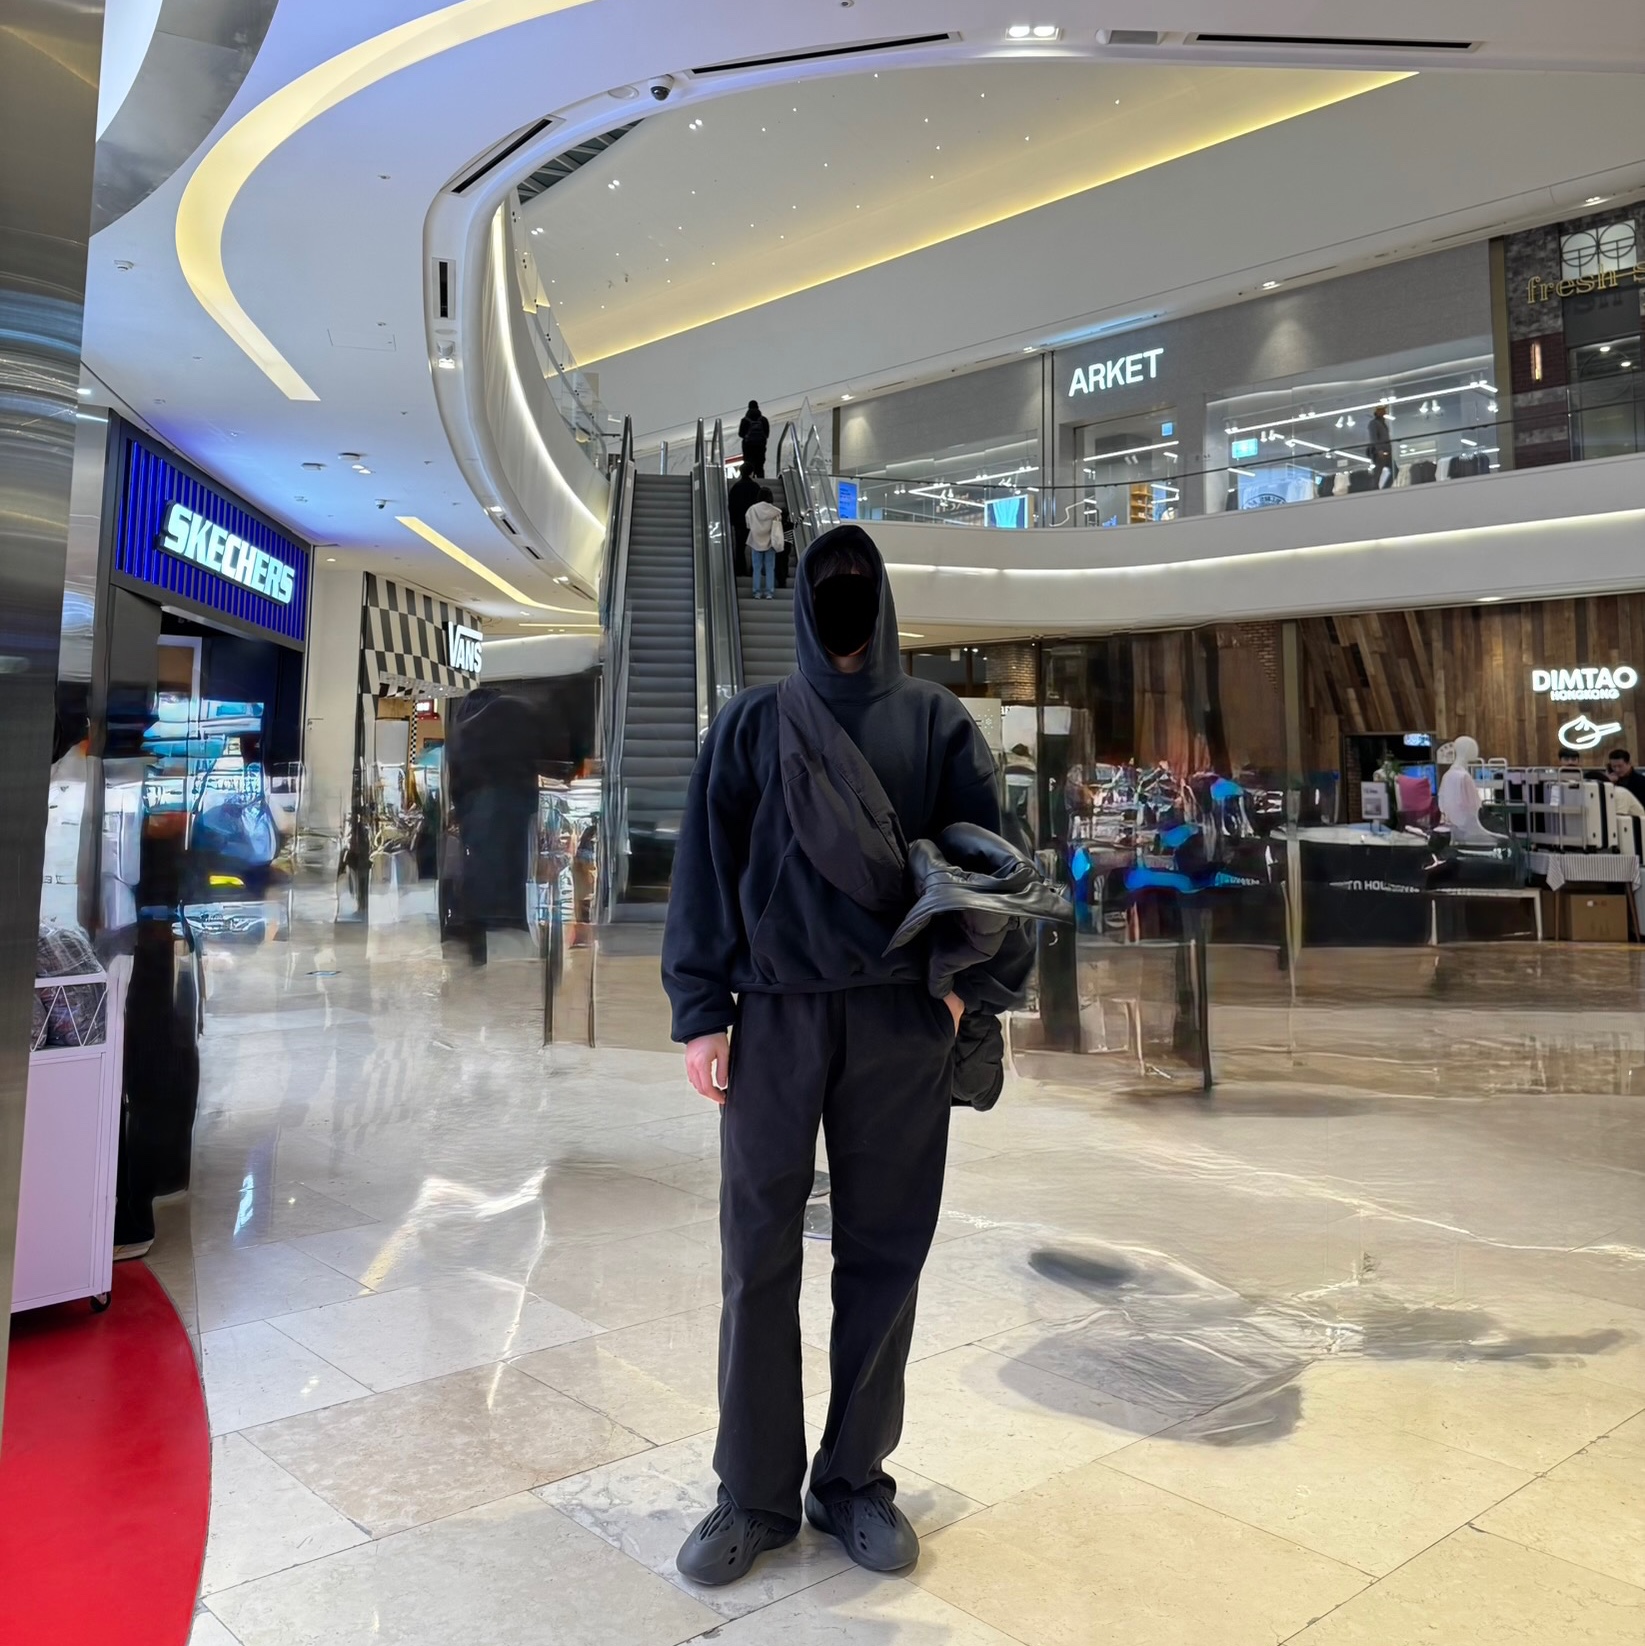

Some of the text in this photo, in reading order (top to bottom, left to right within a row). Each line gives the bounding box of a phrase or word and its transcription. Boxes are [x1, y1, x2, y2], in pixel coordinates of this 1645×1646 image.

[1526, 263, 1618, 304] fresh
[1068, 348, 1164, 397] ARKET
[164, 503, 295, 604] SKECHERS
[448, 621, 483, 673] VANS
[1532, 666, 1638, 691] DIMTAO
